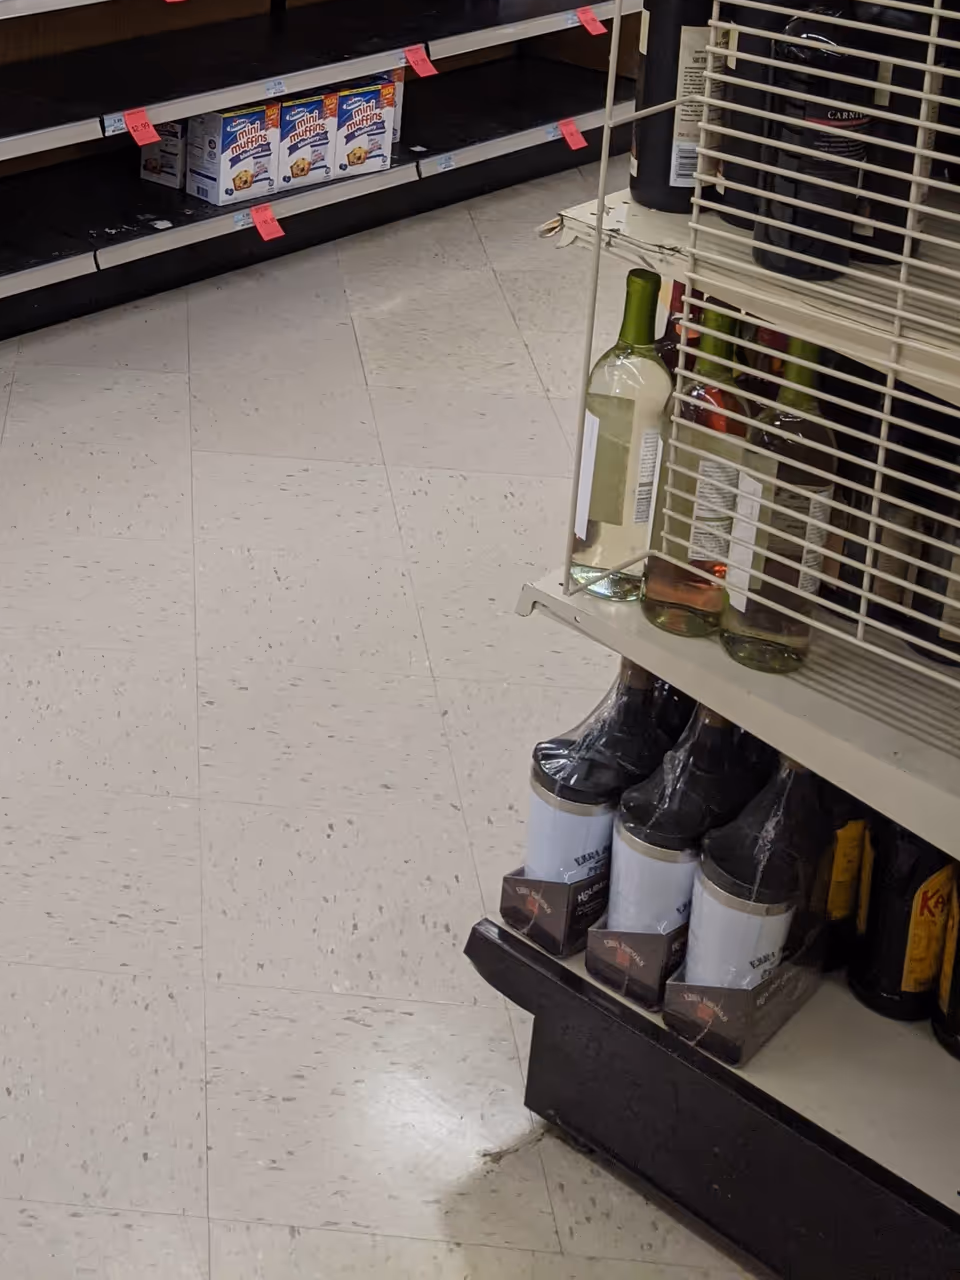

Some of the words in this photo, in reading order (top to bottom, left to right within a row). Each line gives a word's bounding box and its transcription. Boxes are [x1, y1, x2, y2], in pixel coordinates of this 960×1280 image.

[353, 100, 375, 119] mini
[296, 111, 318, 130] mini
[346, 112, 382, 132] muffins
[238, 122, 259, 140] mini
[289, 122, 325, 144] muffins
[230, 134, 268, 156] muffins
[919, 887, 947, 918] KA
